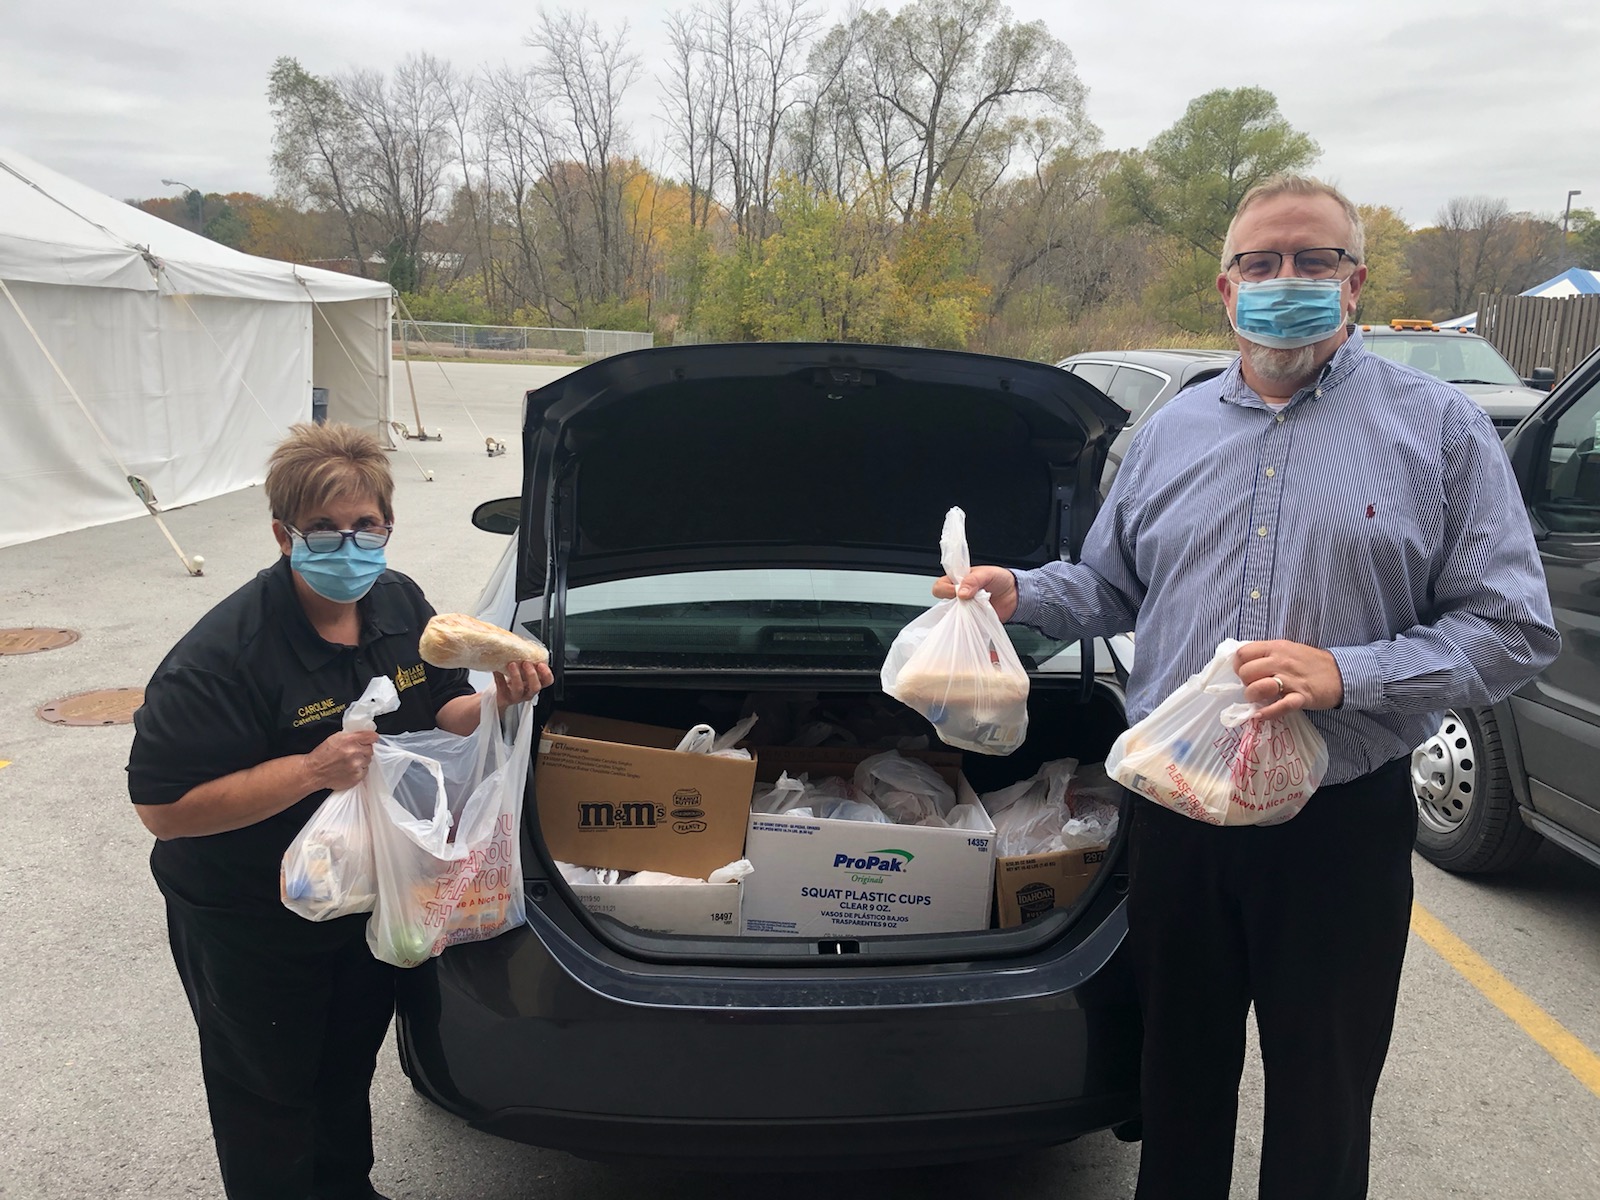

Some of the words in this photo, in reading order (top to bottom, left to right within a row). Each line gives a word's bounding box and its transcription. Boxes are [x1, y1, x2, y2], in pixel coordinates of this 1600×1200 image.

[297, 698, 336, 717] CAROLINE
[293, 712, 321, 728] Catering
[319, 703, 346, 718] Manager
[1264, 758, 1304, 796] YOU
[1165, 763, 1192, 798] PLEASE
[1187, 794, 1210, 818] REUSE
[1169, 790, 1182, 801] AT
[1287, 790, 1304, 801] Day
[677, 823, 702, 831] PEANUT
[967, 838, 989, 847] 14357
[833, 853, 903, 873] ProPak
[1085, 852, 1107, 863] 297
[474, 864, 512, 893] YOU
[851, 874, 884, 885] Originals
[469, 899, 476, 907] A
[477, 895, 496, 906] Nice
[801, 886, 843, 899] SQUAT
[845, 890, 897, 903] PLASTIC
[898, 894, 931, 906] CUPS
[1018, 888, 1054, 904] IDAHOAN
[840, 902, 868, 911] CLEAR
[876, 904, 891, 912] OZ.
[711, 912, 733, 922] 18497
[820, 910, 843, 918] VASOS
[853, 911, 886, 921] PLÁSTICO
[832, 918, 882, 928] TRASPARENTES
